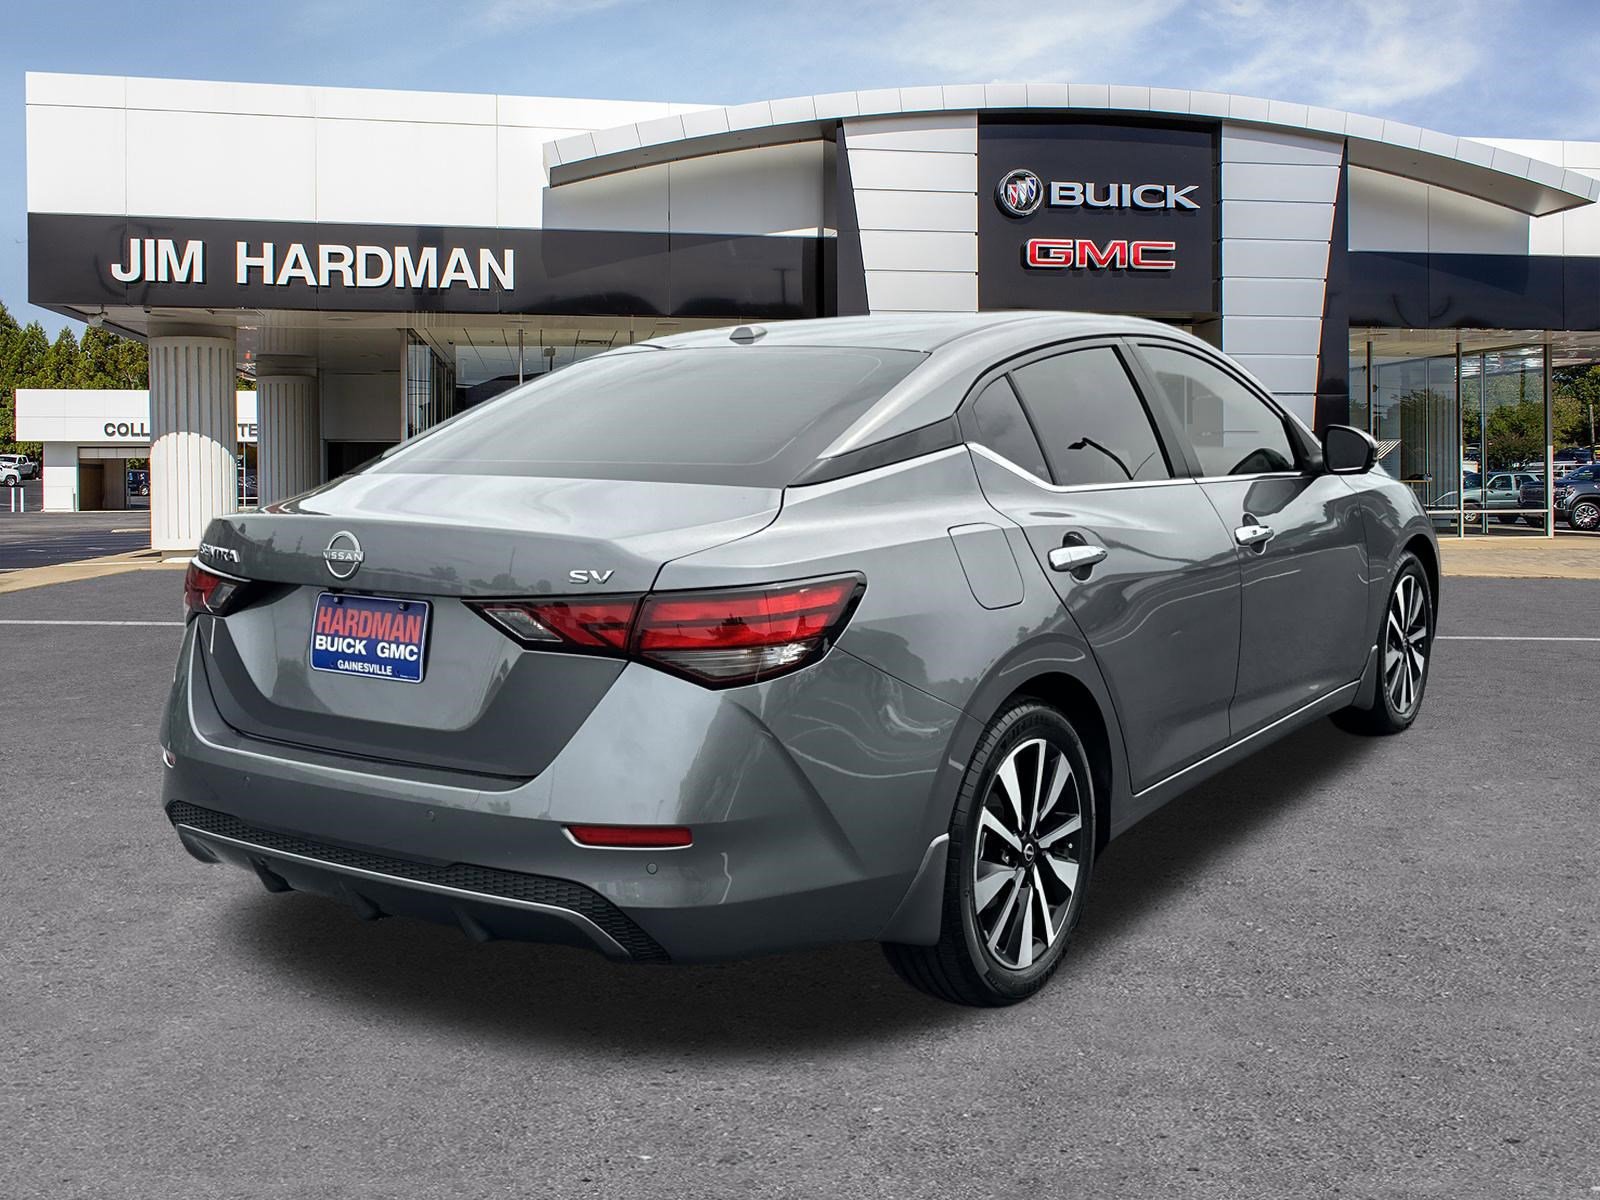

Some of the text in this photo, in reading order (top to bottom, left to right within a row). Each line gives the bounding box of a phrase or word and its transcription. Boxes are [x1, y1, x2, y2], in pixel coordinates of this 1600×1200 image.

[1050, 181, 1201, 209] BUICK
[111, 238, 515, 291] JIM HARDMAN
[1025, 238, 1176, 270] GMC
[104, 422, 258, 438] COLL TE
[322, 551, 365, 562] NISSAN
[568, 569, 616, 585] SV
[316, 606, 422, 644] HARDMAN
[315, 635, 419, 661] BUICK GMC
[337, 659, 393, 675] GAINESVILLE
